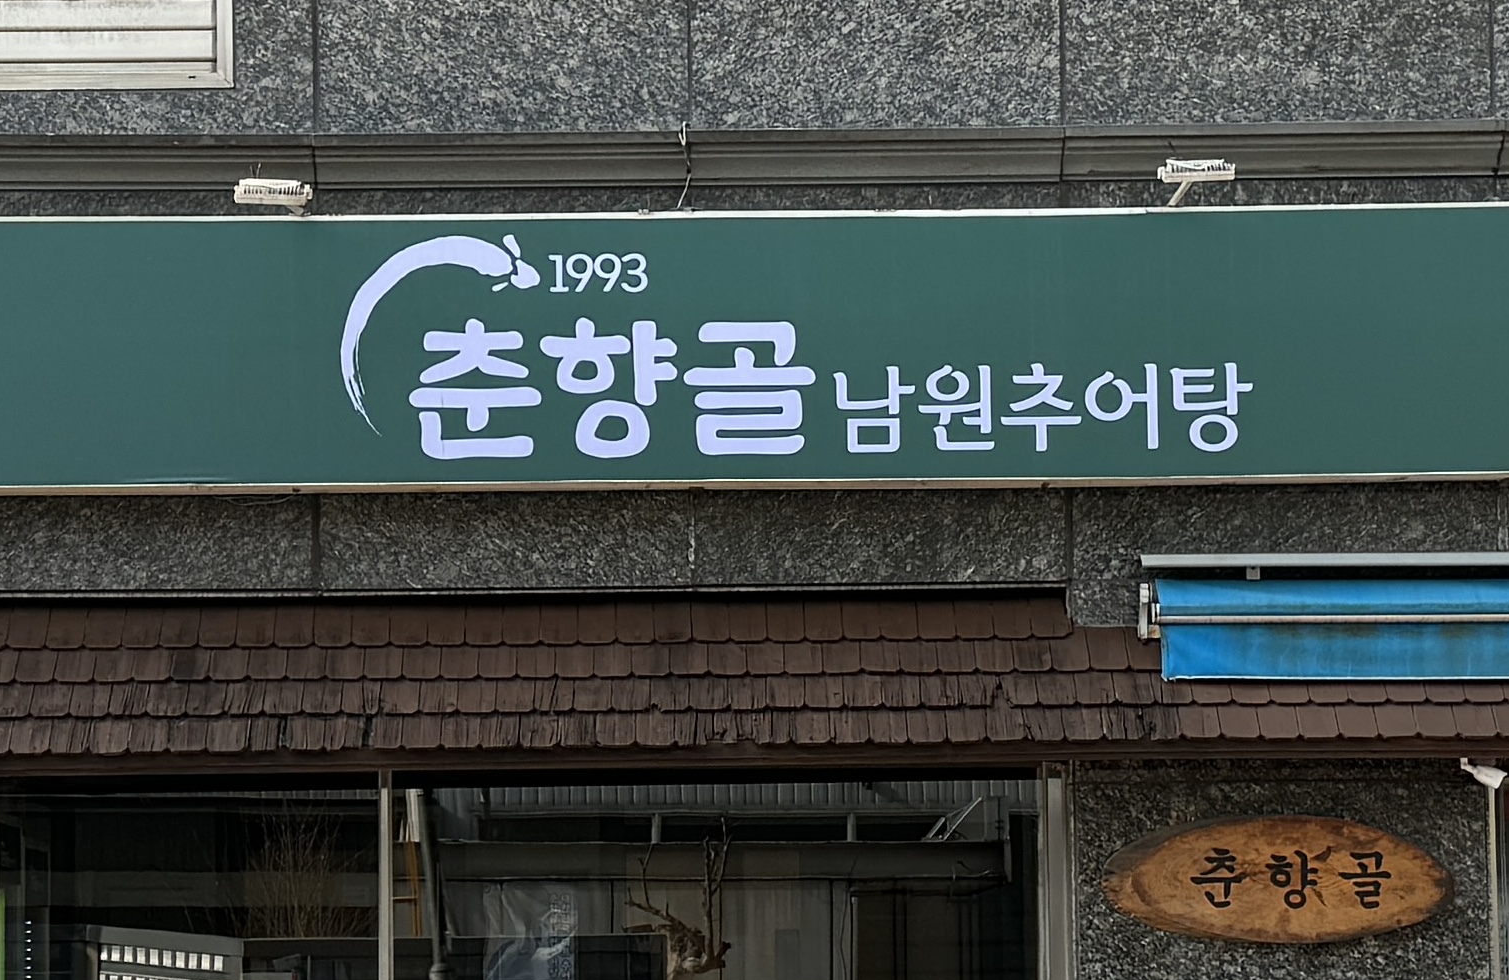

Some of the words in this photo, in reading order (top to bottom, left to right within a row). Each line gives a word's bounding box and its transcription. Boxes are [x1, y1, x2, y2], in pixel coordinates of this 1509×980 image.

[549, 252, 648, 294] 1993
[408, 317, 816, 459] 춘향골
[833, 362, 1253, 453] 남원추어탕
[1190, 847, 1392, 909] 춘향골
